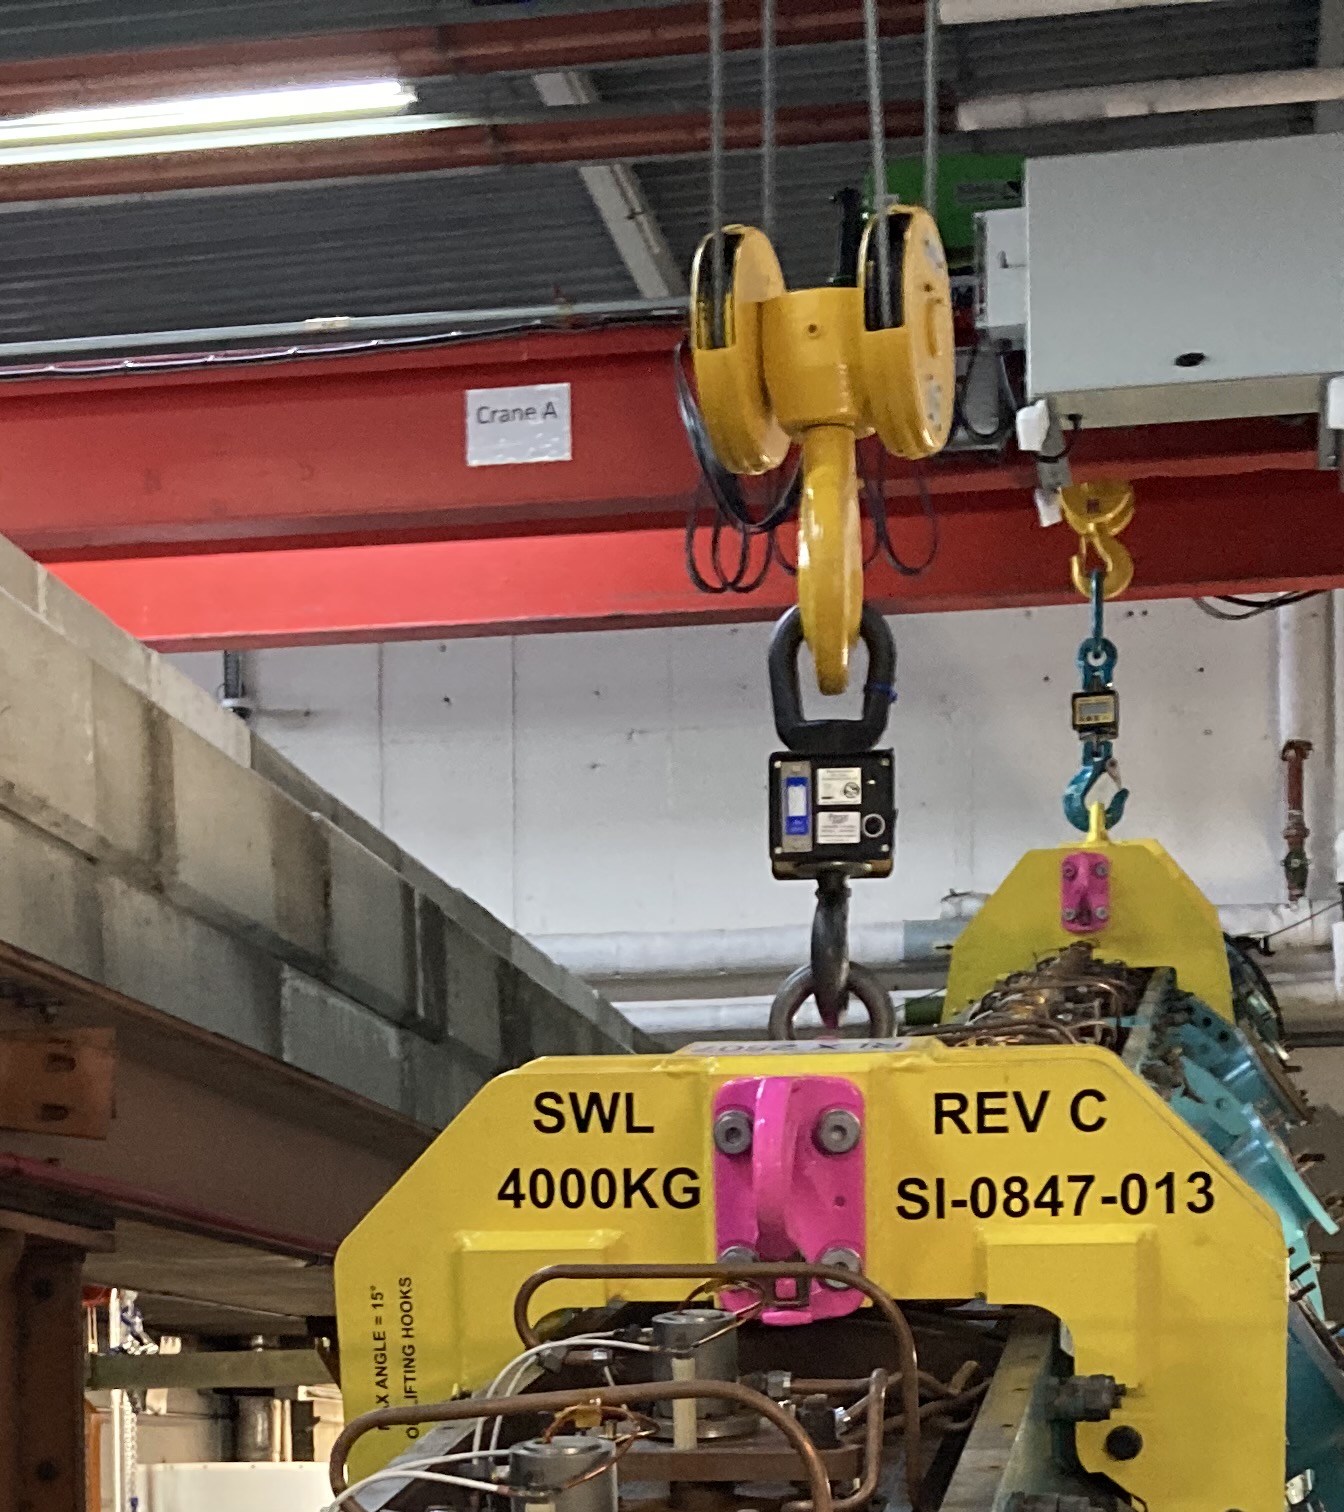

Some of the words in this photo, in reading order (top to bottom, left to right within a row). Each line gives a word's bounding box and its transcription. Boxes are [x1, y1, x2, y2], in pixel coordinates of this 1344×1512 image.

[476, 406, 537, 425] Crane
[543, 401, 558, 419] A
[533, 1091, 654, 1134] SWL
[934, 1089, 1050, 1135] REV
[1070, 1089, 1107, 1133] C
[497, 1167, 701, 1209] 4000KG
[896, 1171, 1215, 1220] SI-0847-013
[398, 1277, 415, 1339] HOOKS
[373, 1331, 390, 1391] ANGLE
[402, 1345, 419, 1405] IFTING
